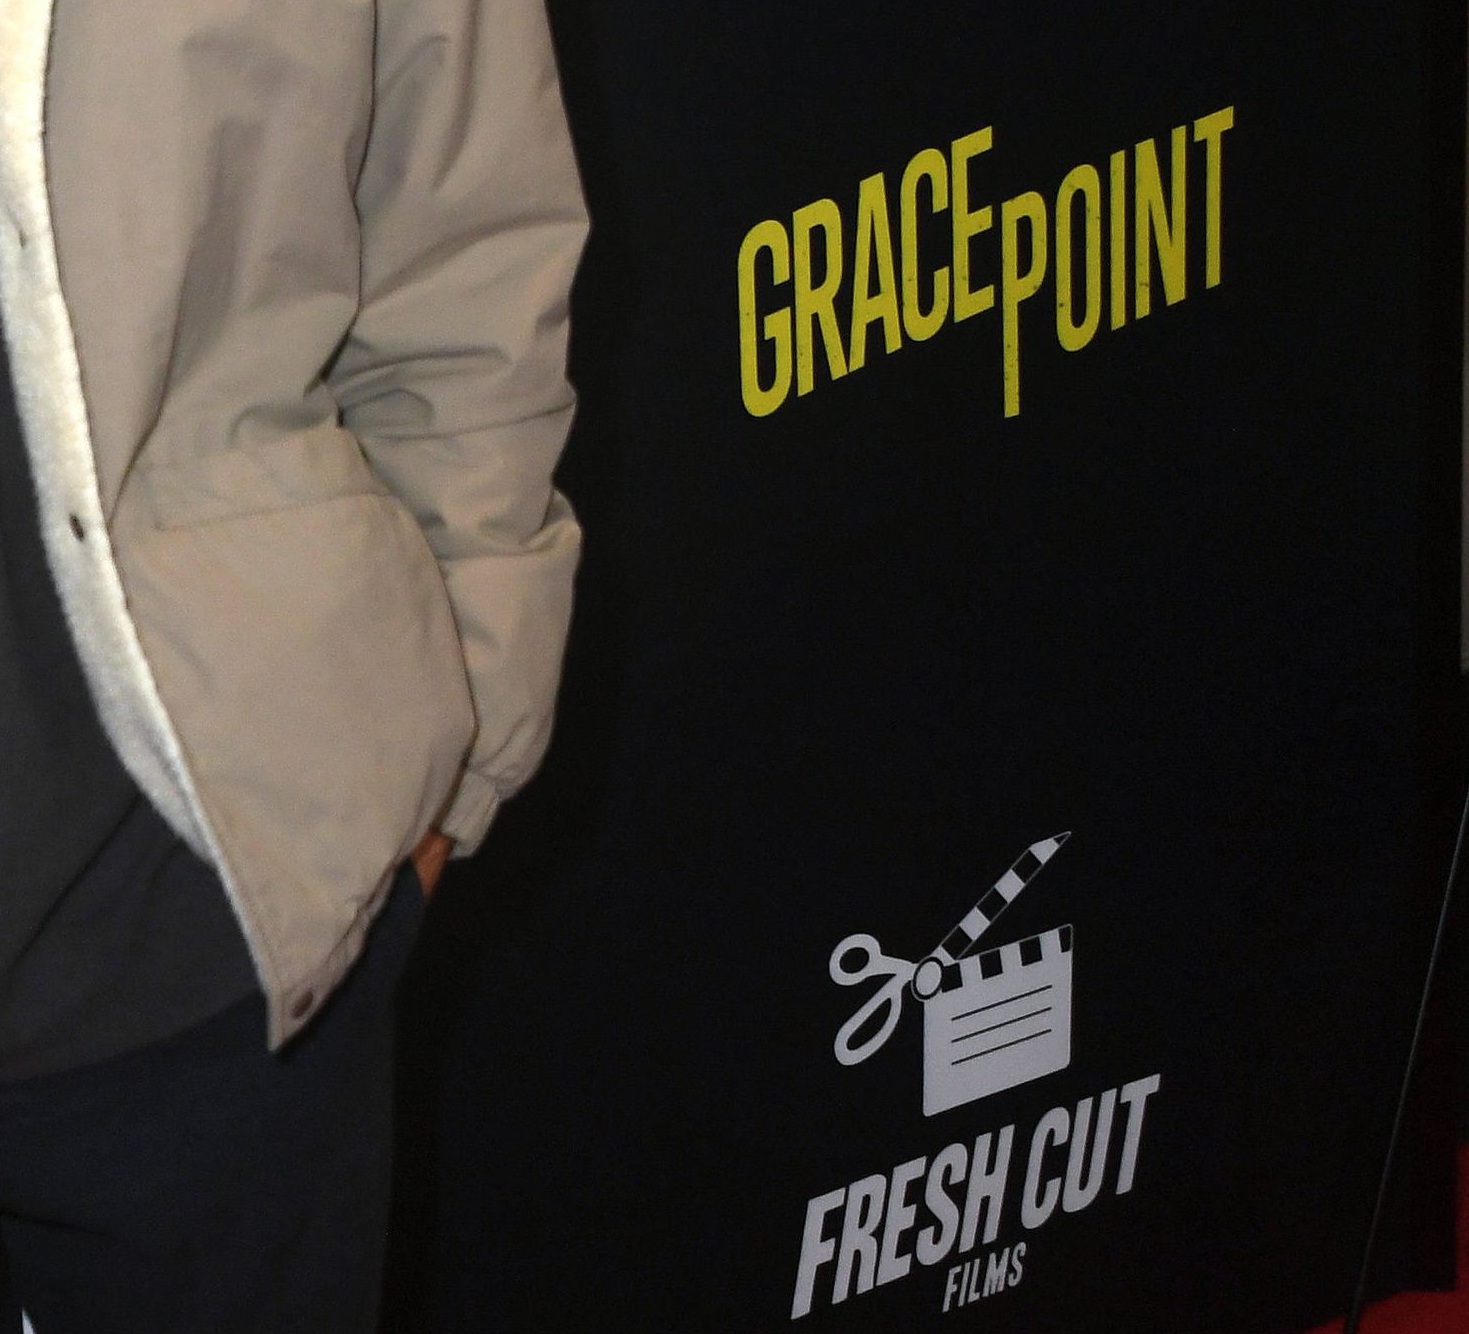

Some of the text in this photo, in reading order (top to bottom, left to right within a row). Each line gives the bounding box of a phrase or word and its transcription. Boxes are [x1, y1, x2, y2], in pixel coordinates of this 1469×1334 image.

[792, 1074, 1160, 1318] FRESH CUT
[944, 1243, 1025, 1311] FILMS
